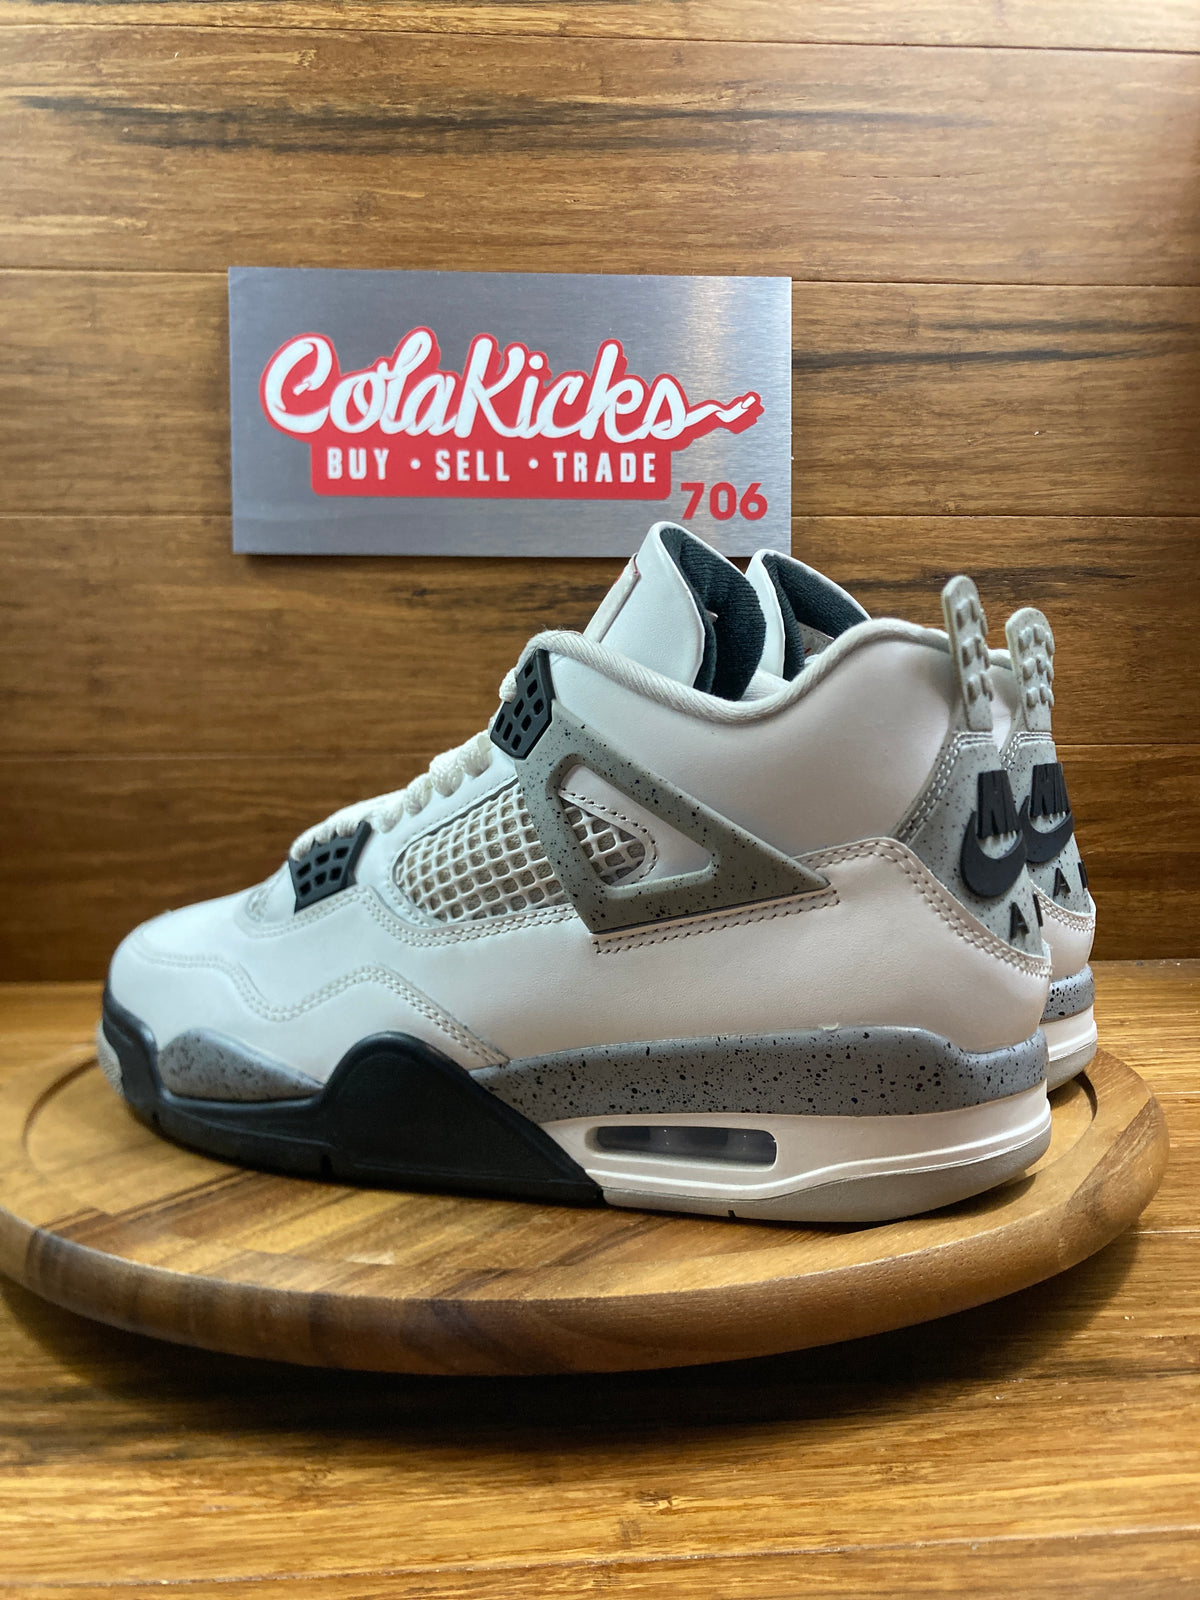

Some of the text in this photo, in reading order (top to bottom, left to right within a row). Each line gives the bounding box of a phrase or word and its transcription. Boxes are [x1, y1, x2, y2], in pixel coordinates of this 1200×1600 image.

[263, 329, 757, 444] ColaKicks
[327, 447, 657, 483] BUY SELL TRADE
[681, 482, 768, 521] 706
